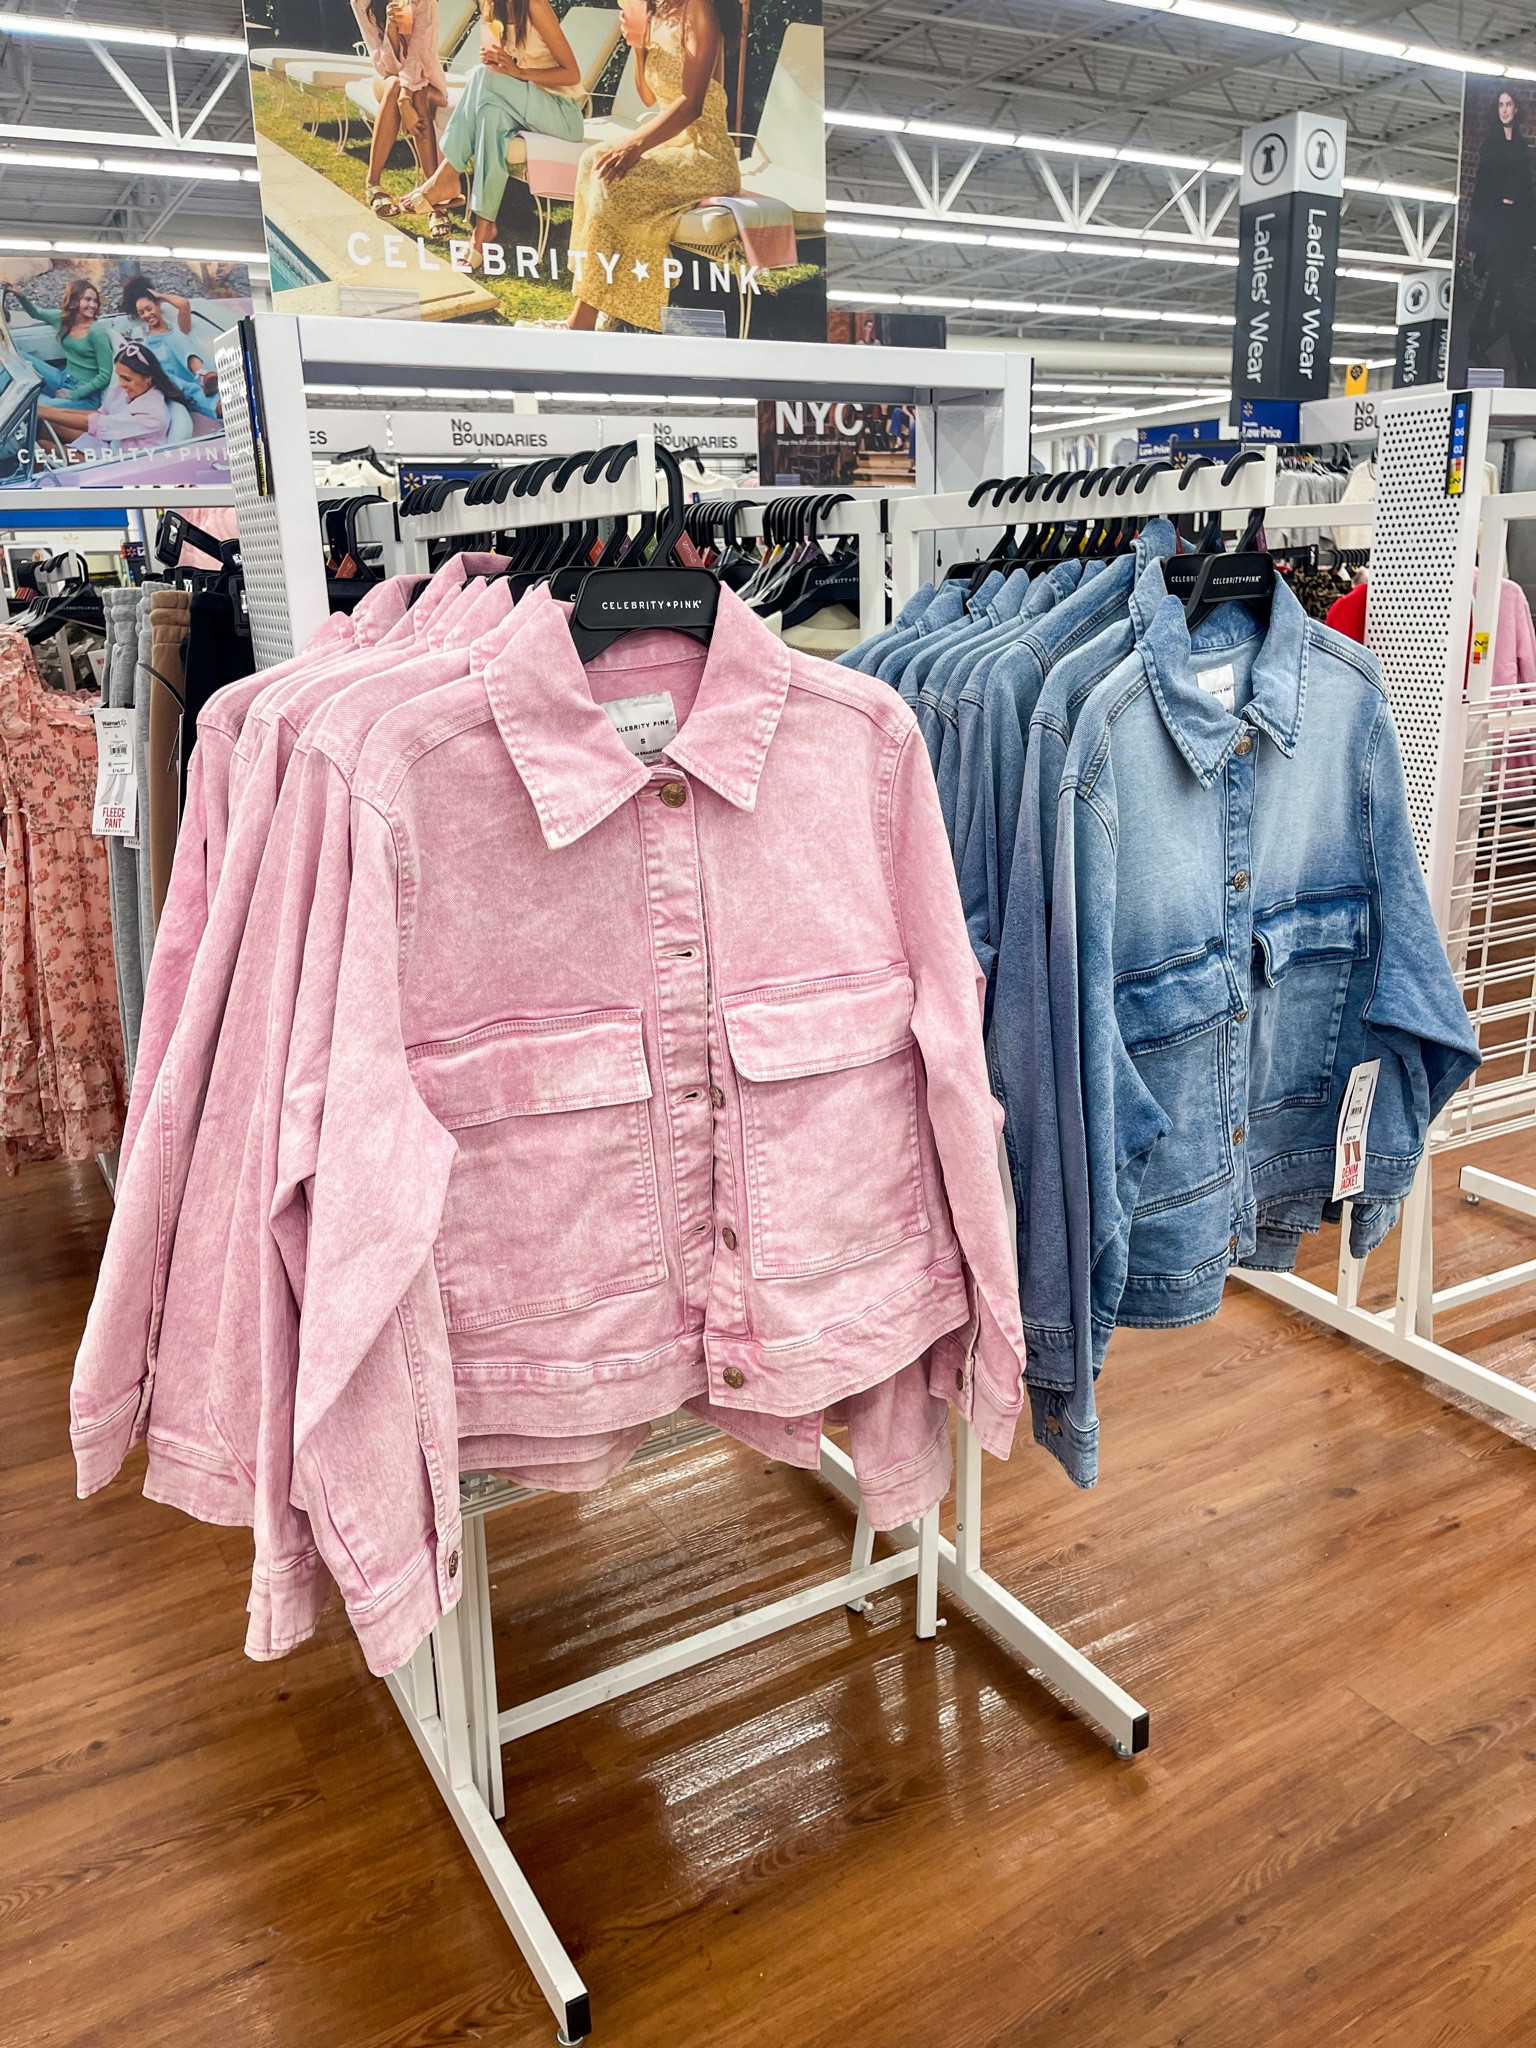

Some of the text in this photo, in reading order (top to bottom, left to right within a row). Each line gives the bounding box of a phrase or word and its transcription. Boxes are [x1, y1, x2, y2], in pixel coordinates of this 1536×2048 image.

[346, 231, 622, 285] CELEBRITY
[1246, 212, 1276, 384] Ladies' Wear
[1298, 208, 1328, 380] Ladies' Wear
[1402, 331, 1421, 383] Men's
[775, 401, 864, 437] NYC
[17, 447, 229, 465] CELEBRITY PIN
[1212, 576, 1242, 585] CELEBRITY
[601, 600, 664, 610] CELEBRITY
[616, 719, 670, 733] ELEBRITY PINK
[102, 806, 126, 818] FLEECE
[105, 818, 122, 828] PANT
[1342, 1163, 1358, 1178] DENIM
[1340, 1174, 1358, 1191] JACKET
